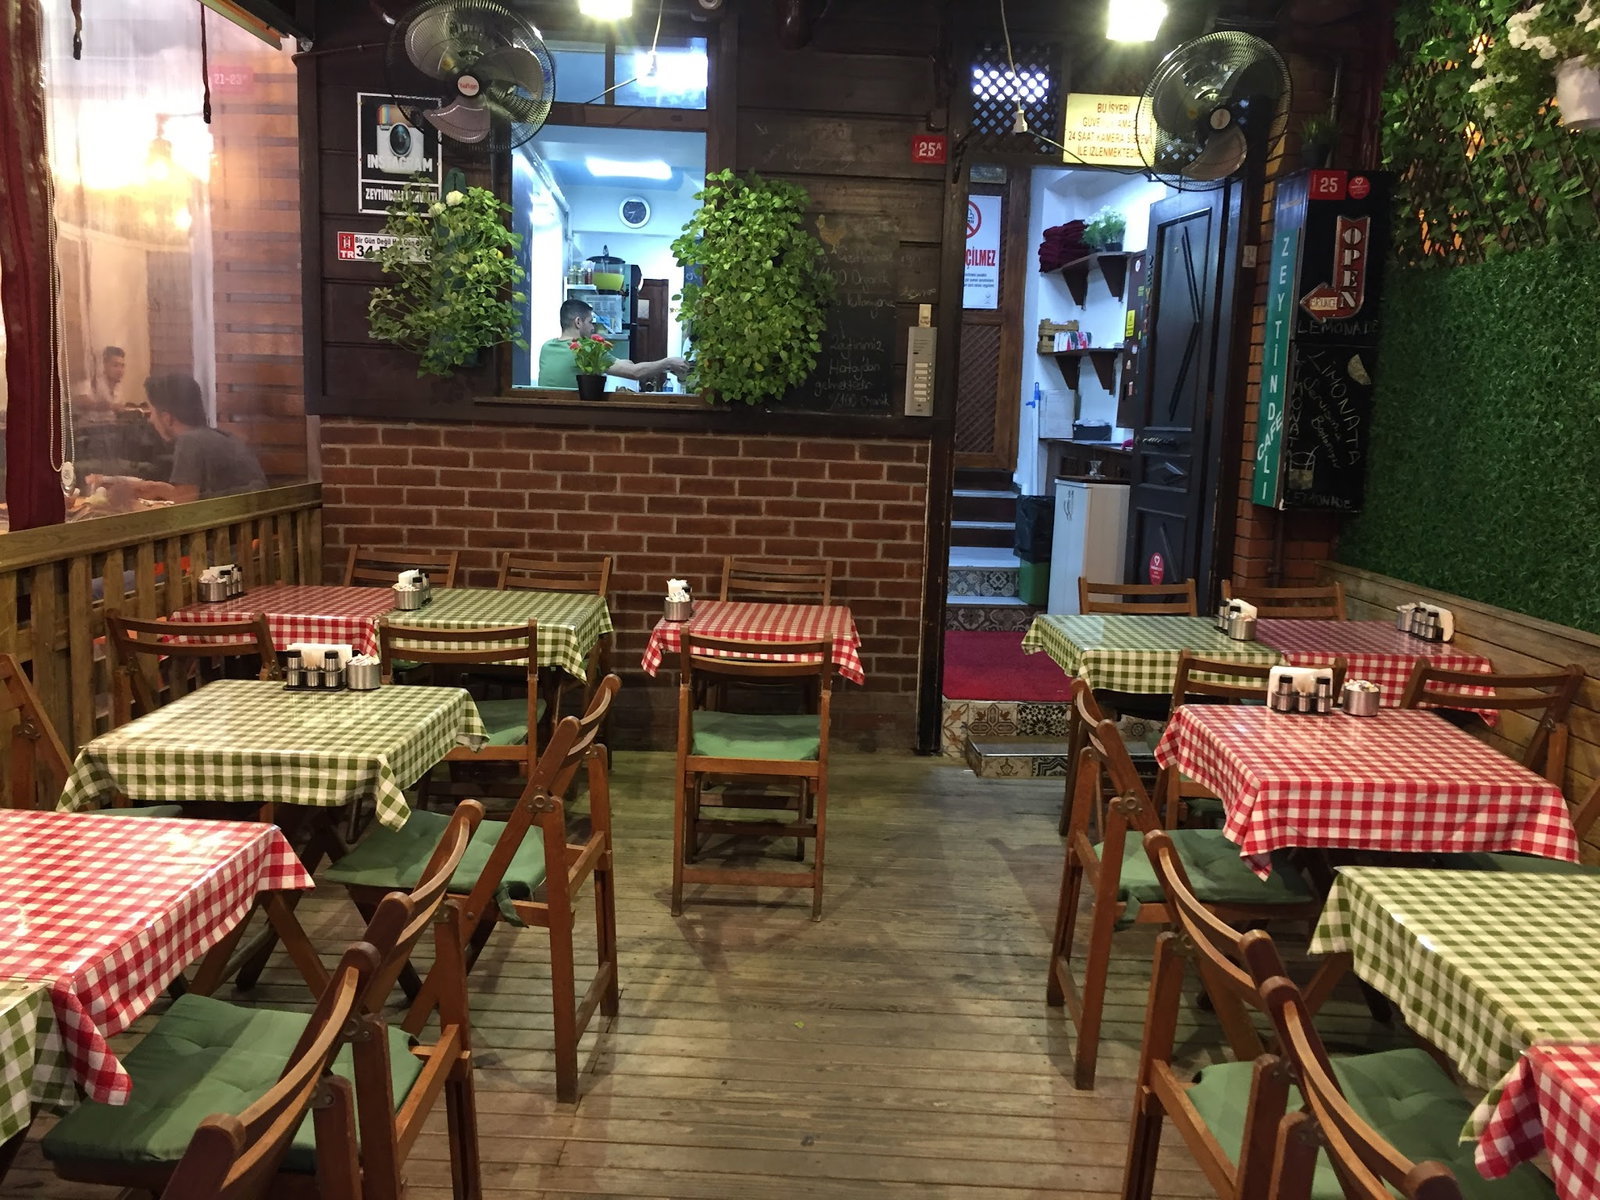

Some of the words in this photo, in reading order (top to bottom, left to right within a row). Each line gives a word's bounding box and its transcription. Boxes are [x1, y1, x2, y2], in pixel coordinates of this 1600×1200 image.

[1097, 103, 1107, 113] BU
[1068, 131, 1076, 141] 24
[1078, 131, 1095, 142] SAAT
[1319, 177, 1339, 193] 25
[364, 237, 376, 245] Gün
[340, 250, 355, 258] TR
[965, 246, 997, 269] ÇİLMEZ
[1339, 227, 1363, 308] OPEN
[1257, 409, 1283, 461] CAFE
